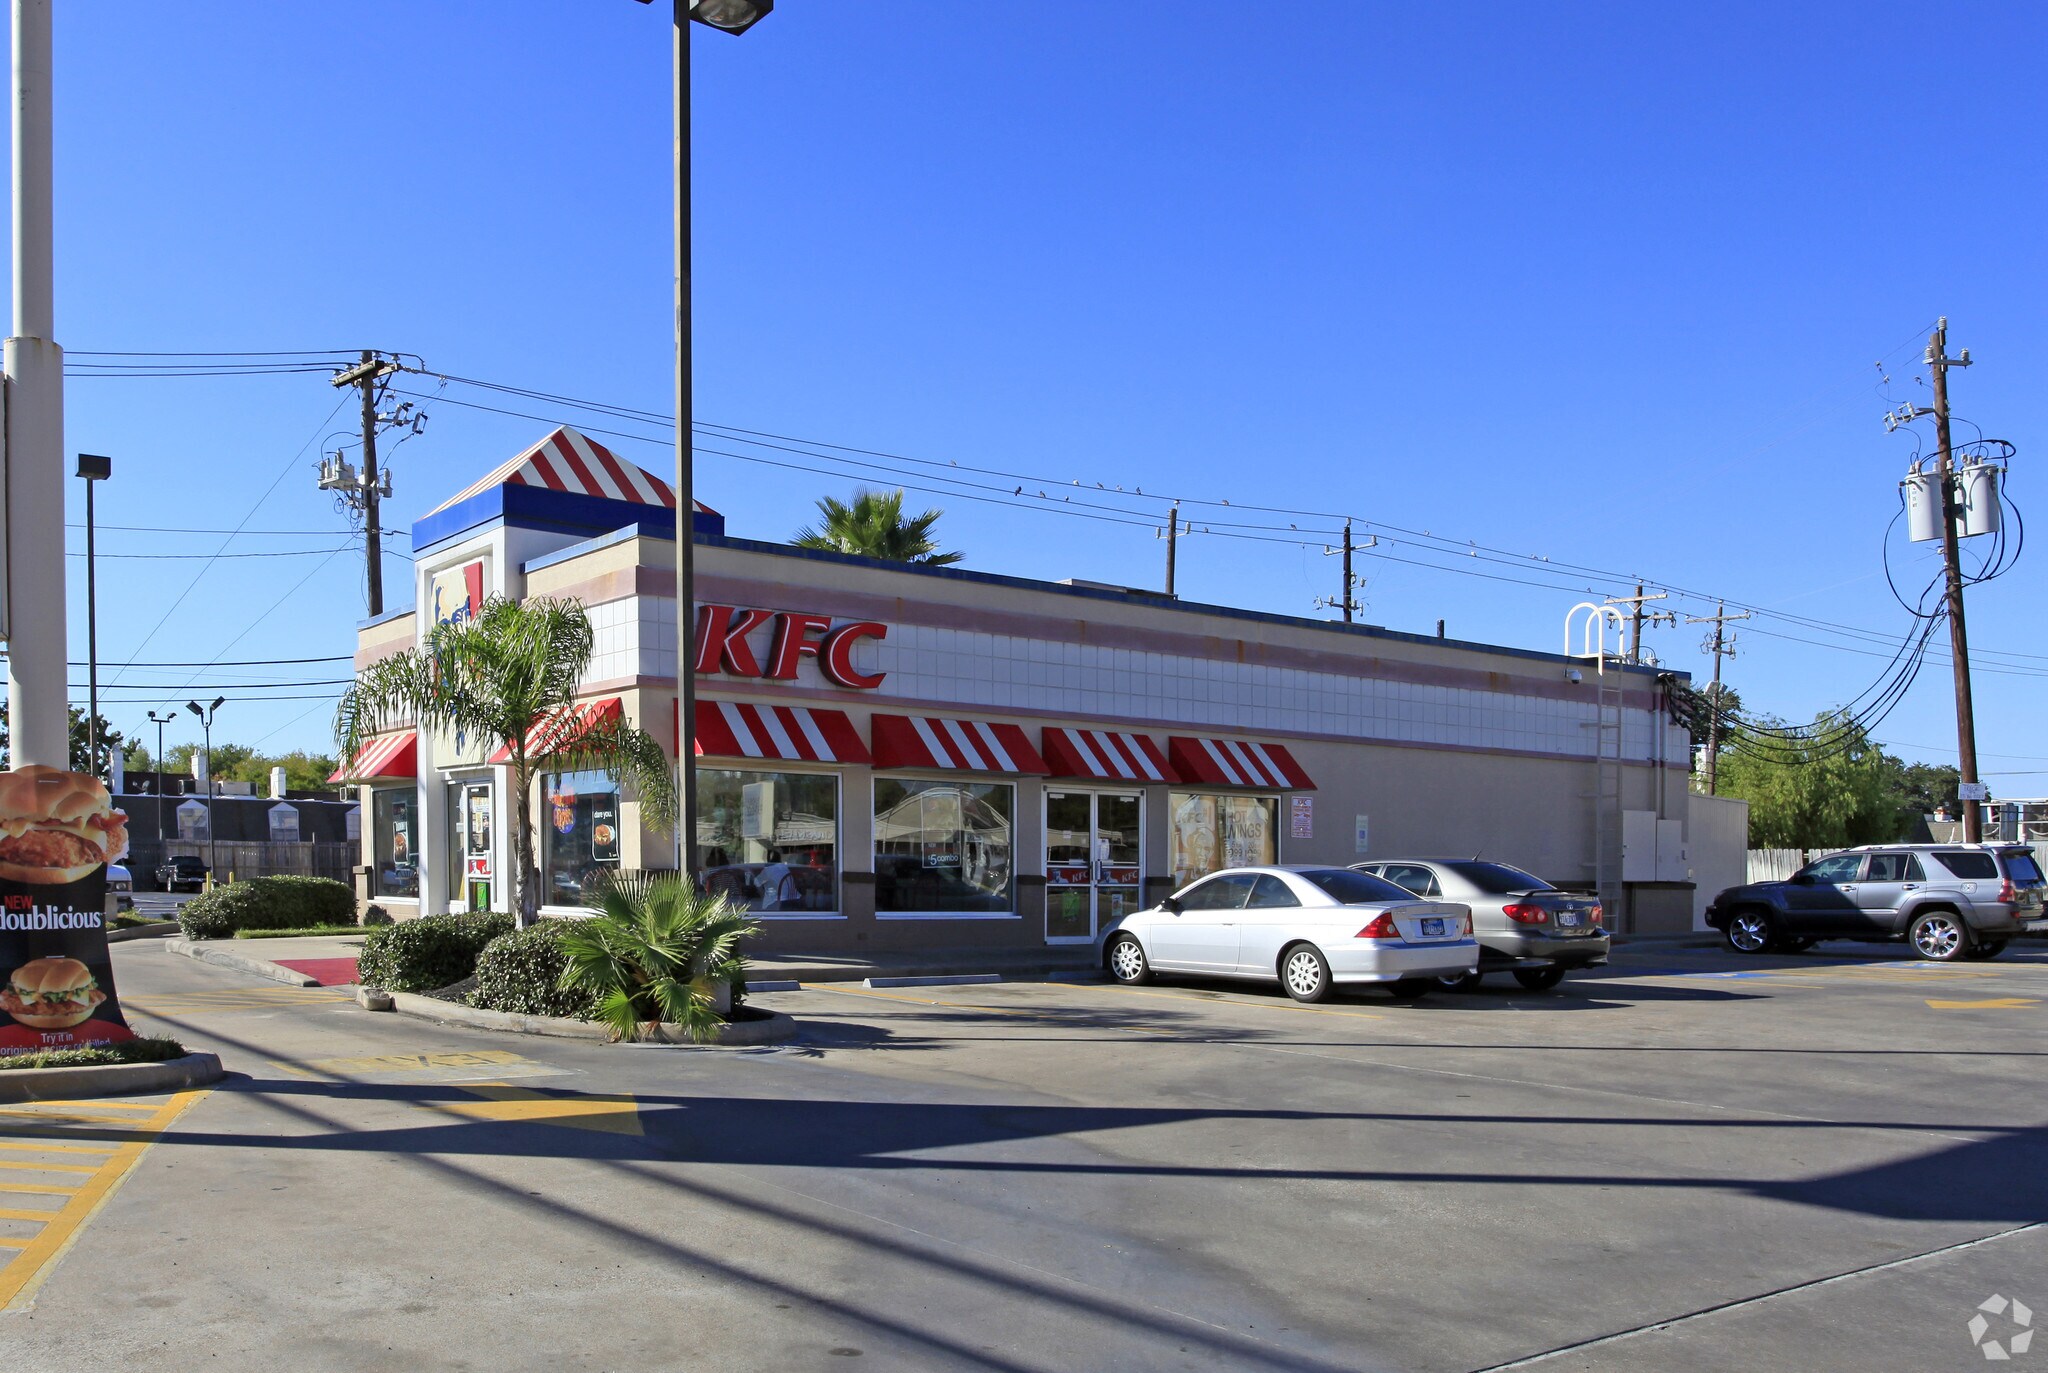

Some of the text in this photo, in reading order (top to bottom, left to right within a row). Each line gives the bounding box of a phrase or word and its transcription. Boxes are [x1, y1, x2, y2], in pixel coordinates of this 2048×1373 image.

[694, 605, 888, 689] KFC
[1227, 823, 1262, 838] WINGS
[1072, 871, 1088, 883] KFC
[1121, 870, 1138, 883] KFC
[4, 895, 33, 910] NEW
[41, 1033, 73, 1044] Try it in
